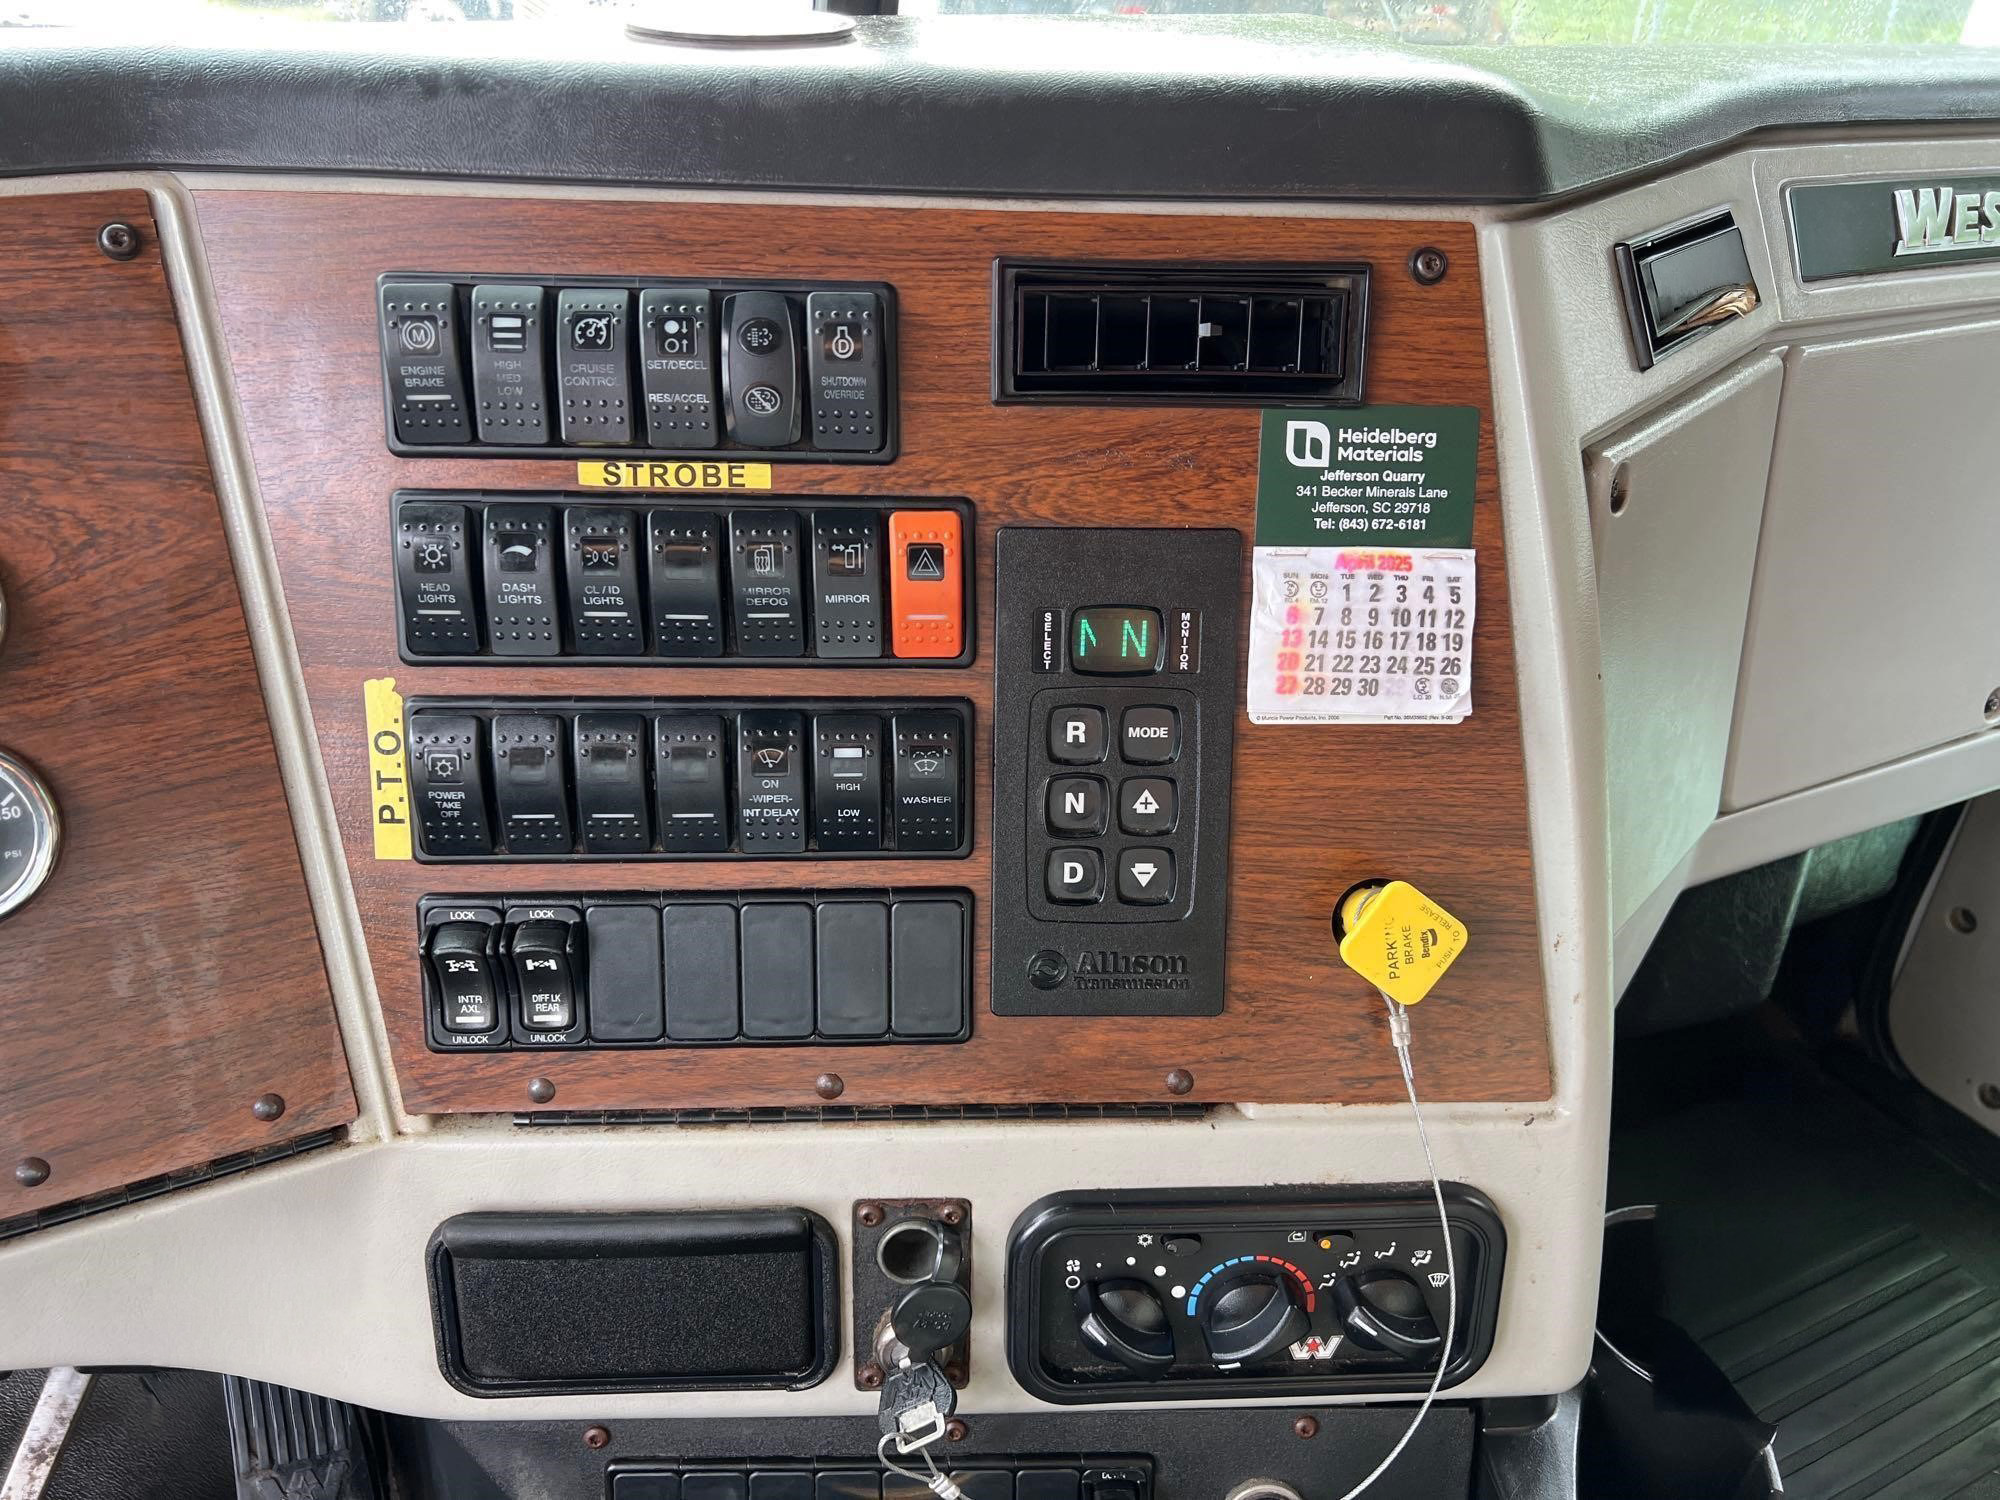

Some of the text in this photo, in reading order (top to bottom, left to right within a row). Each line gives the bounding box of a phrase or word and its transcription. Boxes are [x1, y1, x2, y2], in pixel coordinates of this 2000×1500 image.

[401, 365, 446, 377] ENGINE
[494, 360, 522, 370] HIGH
[570, 363, 616, 374] CRUISE
[647, 359, 708, 371] SET/DECEL
[404, 376, 445, 388] BRAKE
[821, 376, 867, 387] SHUTDOWN
[497, 386, 523, 396] LOW
[824, 389, 865, 400] OVERRIDE
[648, 392, 711, 404] RES/ACCEL
[1338, 426, 1438, 449] Heidelberg
[1338, 446, 1424, 462] Materials
[603, 462, 746, 487] STROBE
[1319, 470, 1426, 484] Jefferson Quarry
[1296, 486, 1449, 498] 341 Becker Minerals Lane
[1311, 502, 1431, 515] Jefferson, SC 29718
[1314, 518, 1427, 532] Tel: (843) 672-6181
[1377, 554, 1413, 571] 2025
[420, 582, 451, 592] HEAD
[502, 582, 536, 592] DASH
[742, 586, 791, 596] MIRROR
[418, 592, 456, 604] LIGHTS
[499, 593, 543, 605] LIGHTS
[825, 593, 871, 604] MIRROR
[1343, 584, 1461, 604] 1 2 3 4 5
[583, 596, 624, 606] LIGHTS
[746, 596, 789, 607] DEFOG
[1286, 605, 1465, 629] 6 7 8 9 10 11 12
[1043, 611, 1053, 670] SELECT
[1122, 619, 1148, 657] N
[1179, 612, 1191, 670] MONITOR
[1281, 630, 1463, 652] 13 14 15 16 17 18 19
[1276, 653, 1461, 675] 20 21 22 23 24 25 26
[1276, 676, 1379, 696] 27 28 29 30
[1066, 721, 1086, 743] R
[1128, 727, 1169, 739] MODE
[373, 717, 406, 826] P.T.O.
[762, 779, 779, 789] ON
[836, 783, 862, 792] HIGH
[428, 790, 466, 800] POWER
[901, 795, 951, 805] WASHER
[436, 801, 462, 810] TAKE
[1065, 792, 1085, 813] N
[0, 805, 22, 822] 50
[440, 810, 461, 819] OFF
[743, 808, 801, 817] INT DELAY
[837, 808, 861, 818] LOW
[4, 849, 23, 860] PSI
[1063, 863, 1084, 884] D
[450, 911, 476, 920] LOCK
[529, 909, 556, 919] LOCK
[1418, 903, 1460, 969] PUSH TO RELEASE
[1384, 914, 1401, 981] PARK
[1401, 924, 1415, 965] BRAKE
[1420, 929, 1431, 960] Bendix
[1074, 950, 1190, 975] Allison
[1073, 975, 1190, 991] Transmission
[458, 994, 484, 1004] INTR
[532, 994, 561, 1002] DIFF LK
[460, 1004, 481, 1013] AXL
[535, 1003, 560, 1012] REAR
[452, 1035, 489, 1044] UNLOCK
[530, 1034, 567, 1043] UNLOCK
